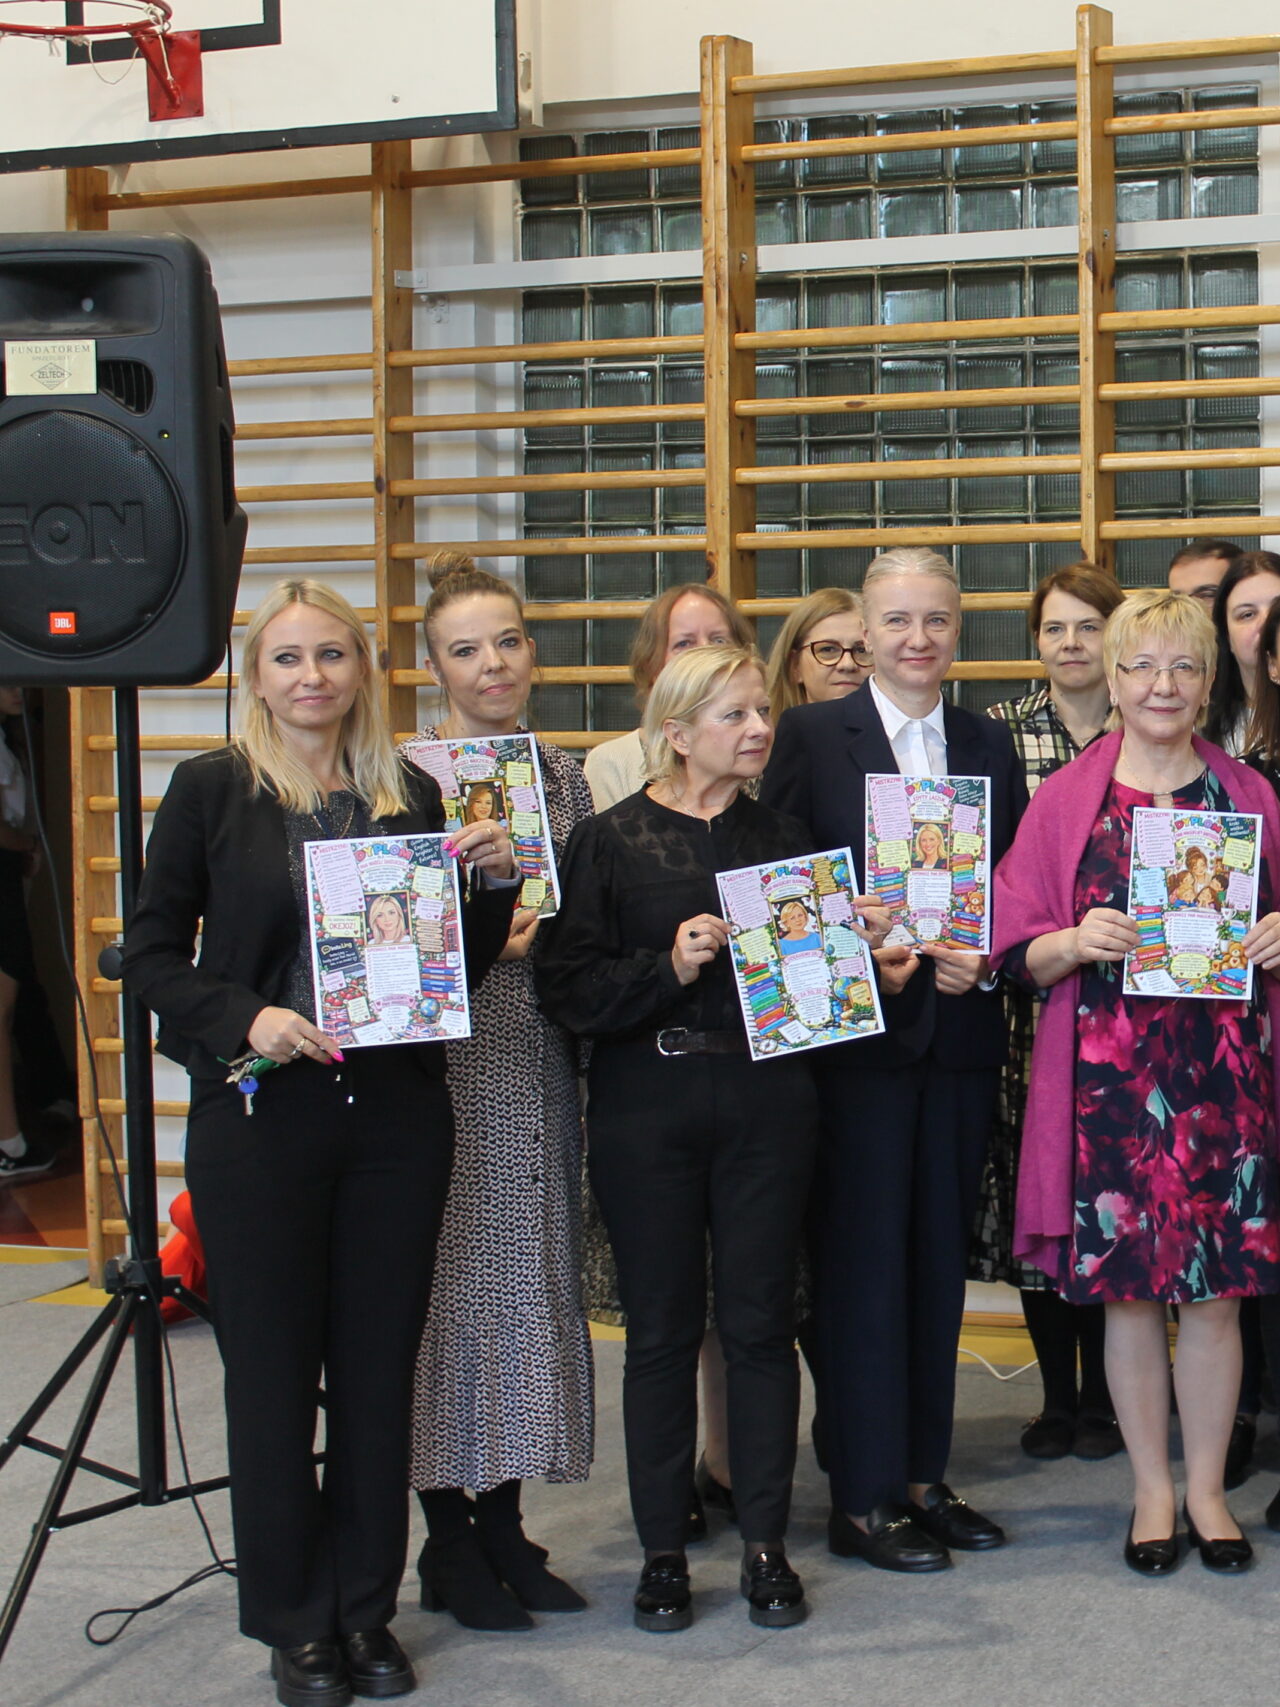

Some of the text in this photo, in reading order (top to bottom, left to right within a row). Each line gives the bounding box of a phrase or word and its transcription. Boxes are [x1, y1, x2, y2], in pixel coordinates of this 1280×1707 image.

[11, 345, 90, 354] FUNDATOREM
[38, 371, 65, 379] ZELTECH
[54, 618, 71, 628] JBL
[449, 745, 497, 760] DYPLOM
[905, 780, 956, 798] DYPLOM
[1174, 817, 1222, 833] DYPLOM
[354, 843, 413, 861] DYPLOM
[761, 866, 811, 885] DYPLOM
